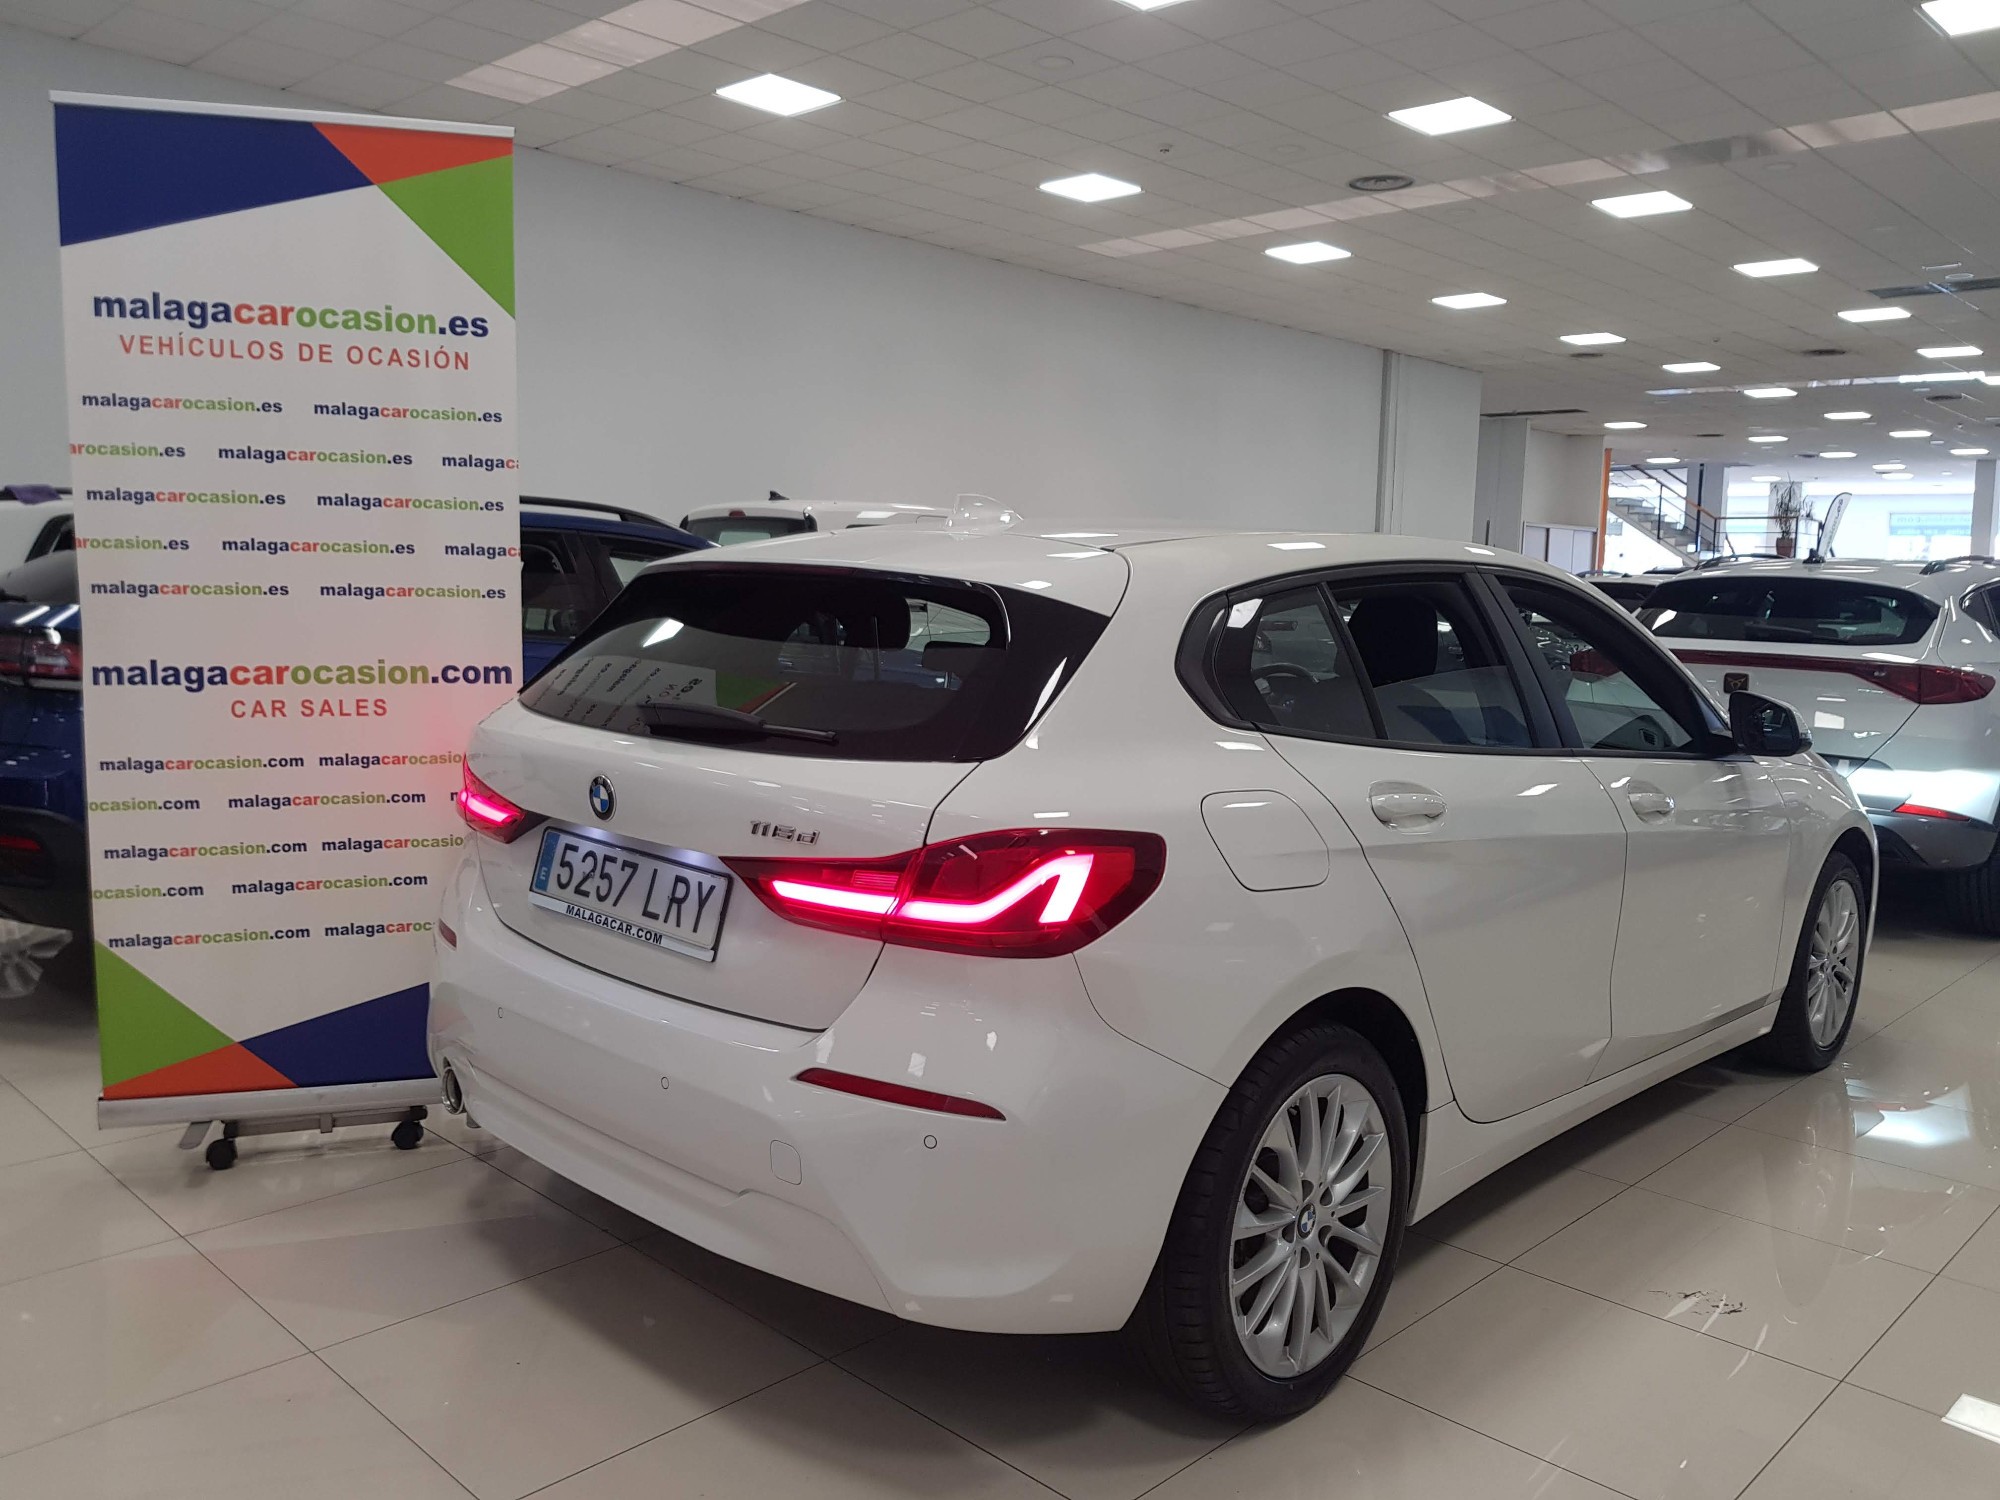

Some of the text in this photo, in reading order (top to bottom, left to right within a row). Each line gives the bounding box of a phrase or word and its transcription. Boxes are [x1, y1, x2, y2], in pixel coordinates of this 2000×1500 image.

[93, 291, 489, 337] malagacarocasion.es
[120, 332, 468, 370] VEHÍCULOS DE OCASIÓN
[82, 393, 502, 422] malagacarocasion.es malagacarocasion.es
[219, 445, 412, 465] malagacarocasion.es
[87, 487, 504, 511] malagacarocasion.es malagacarocasion.es
[222, 538, 415, 555] malagacarocasion.es
[91, 580, 506, 600] malagacarocasion.es malagacarocasion.es
[92, 659, 512, 693] malagacarocasion.com
[231, 699, 387, 718] CAR SALES
[100, 751, 462, 774] malagacarocasion.com malagacarocasio
[89, 792, 426, 812] ocasion.com malagacarocasion.com
[104, 834, 464, 861] malagacarocasion.com malagacarocasio
[93, 875, 428, 899] ocasion.com malagacarocasion.com
[556, 843, 716, 933] 5257 LRY
[108, 922, 434, 949] malagacarocasion.com malagacaroc
[565, 904, 664, 945] MALAGACAR.COM
